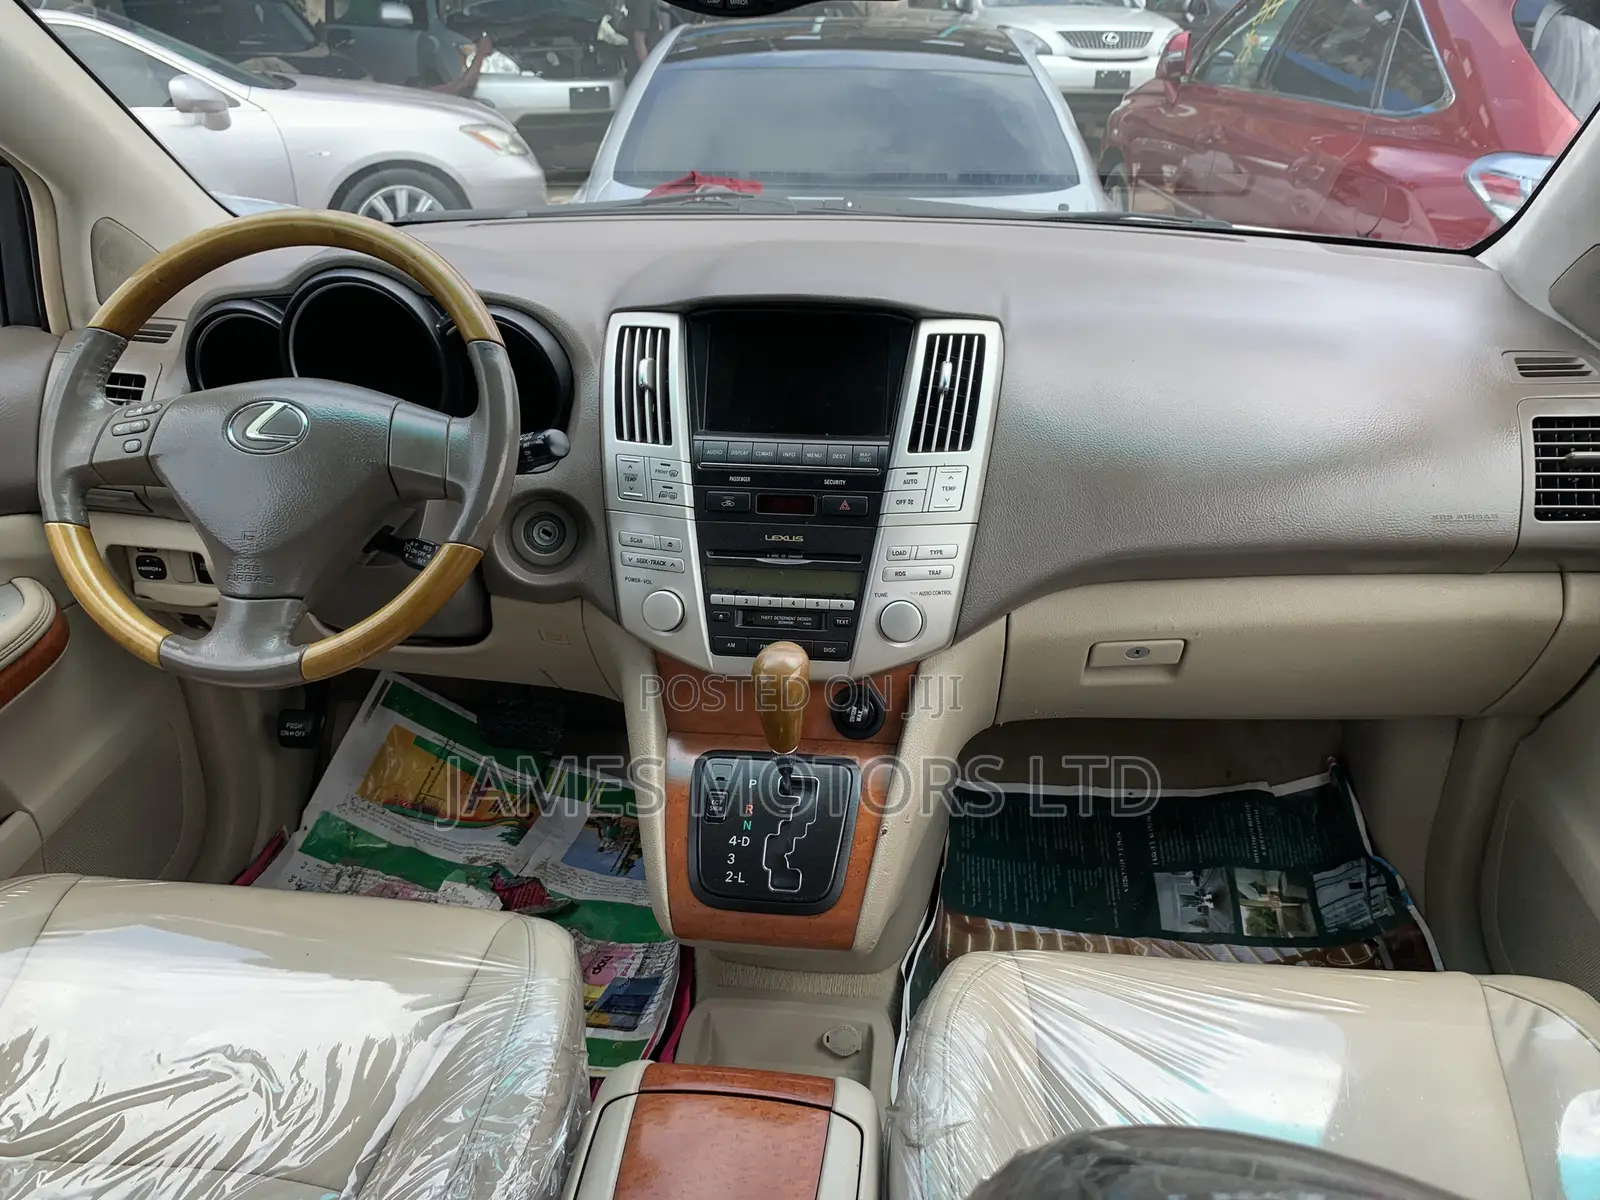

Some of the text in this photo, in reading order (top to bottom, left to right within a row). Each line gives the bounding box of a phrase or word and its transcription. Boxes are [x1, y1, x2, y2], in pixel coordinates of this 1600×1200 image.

[764, 534, 804, 542] LEXUS
[286, 721, 304, 729] PUSH
[749, 779, 757, 789] P
[745, 804, 753, 815] R
[743, 820, 752, 831] N
[728, 835, 750, 847] 4-D
[727, 853, 735, 864] 3
[725, 871, 746, 883] 2-L
